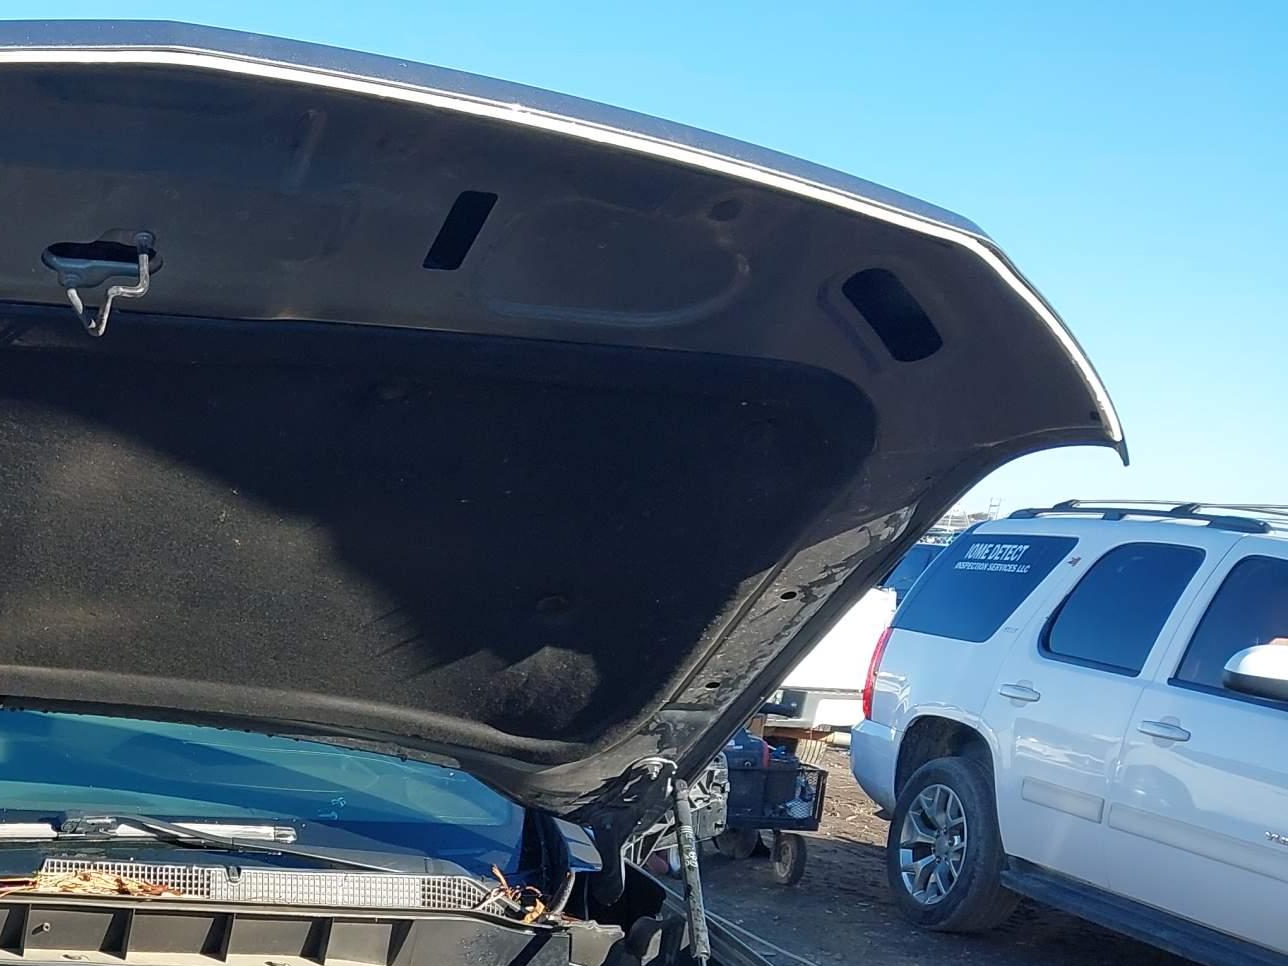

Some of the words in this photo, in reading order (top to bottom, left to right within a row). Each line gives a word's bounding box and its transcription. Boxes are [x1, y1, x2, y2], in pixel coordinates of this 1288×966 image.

[987, 544, 1030, 561] DETECT
[987, 563, 1017, 573] SERVICES
[1016, 564, 1030, 574] LLC
